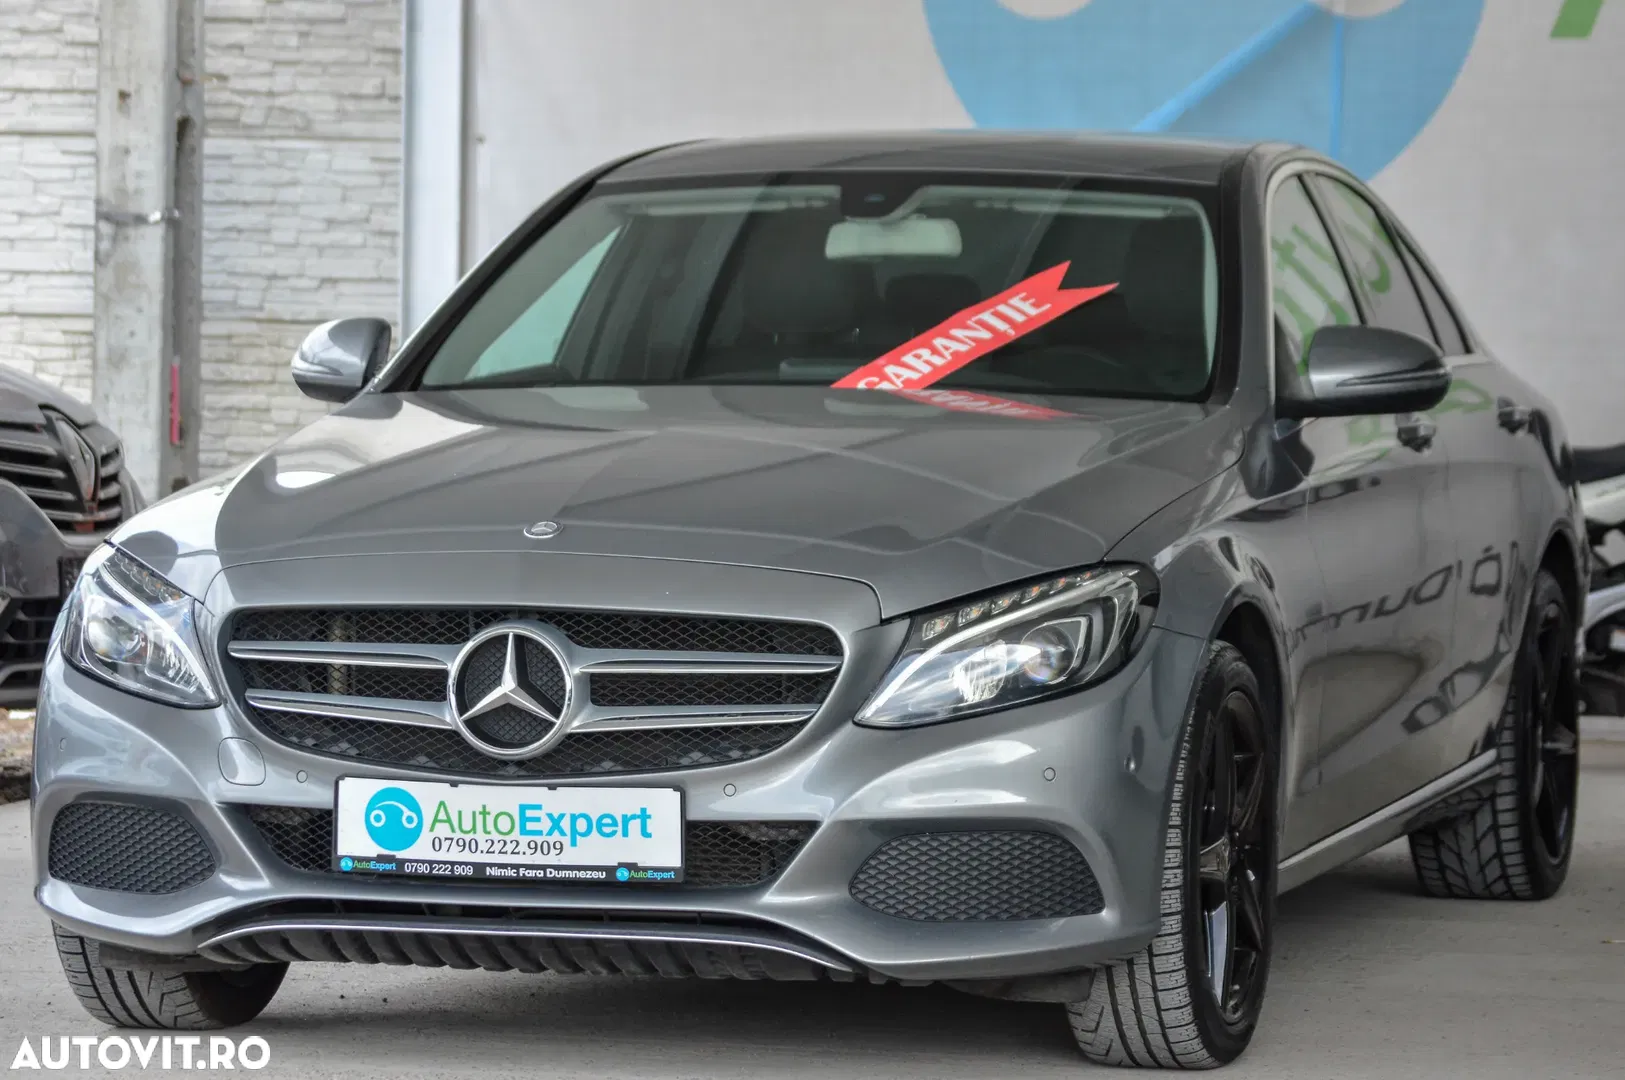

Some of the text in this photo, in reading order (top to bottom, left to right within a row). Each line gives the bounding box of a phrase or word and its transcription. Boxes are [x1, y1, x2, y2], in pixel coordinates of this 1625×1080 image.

[429, 800, 652, 847] AutoExpert
[431, 836, 565, 857] 0790.222.909
[353, 860, 396, 872] AutoExpert
[404, 862, 473, 875] 0790 222 909
[486, 866, 606, 879] Nimic Fara Dumnezeu
[629, 870, 675, 881] AutoExpert
